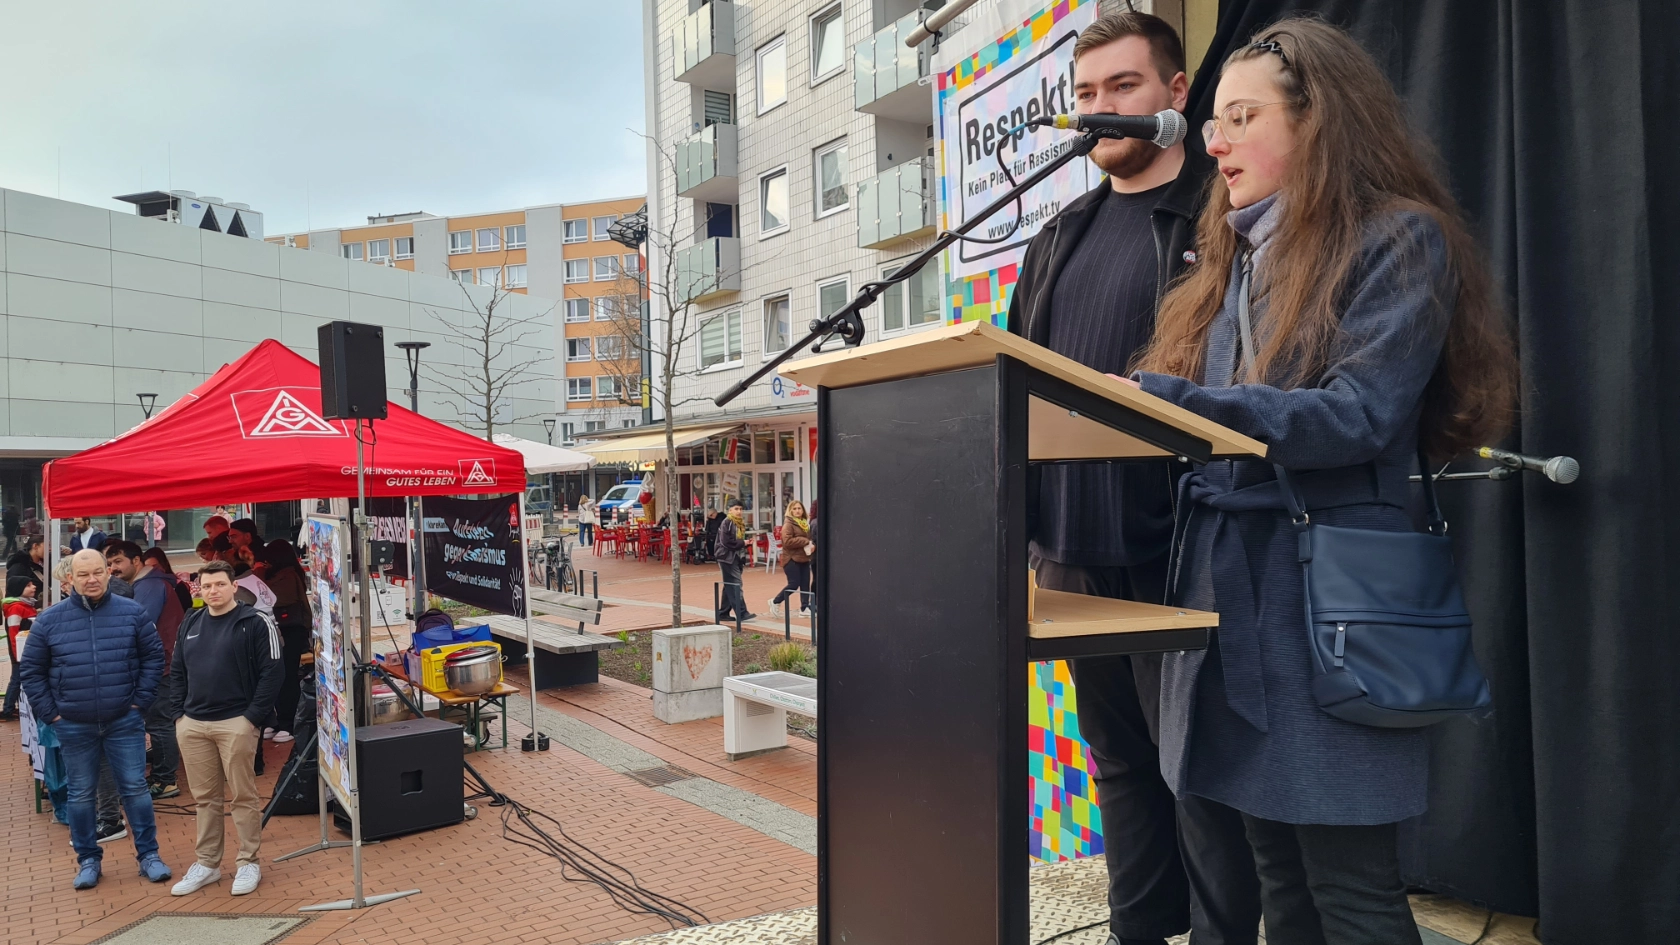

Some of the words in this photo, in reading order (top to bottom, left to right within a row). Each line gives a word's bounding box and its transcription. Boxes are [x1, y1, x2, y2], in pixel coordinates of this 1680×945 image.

[966, 60, 1076, 166] Respekt!
[968, 175, 988, 197] Kein
[1013, 159, 1026, 177] für
[1028, 135, 1078, 171] Rassismu
[386, 477, 421, 487] GUTES
[423, 477, 456, 487] LEBEN
